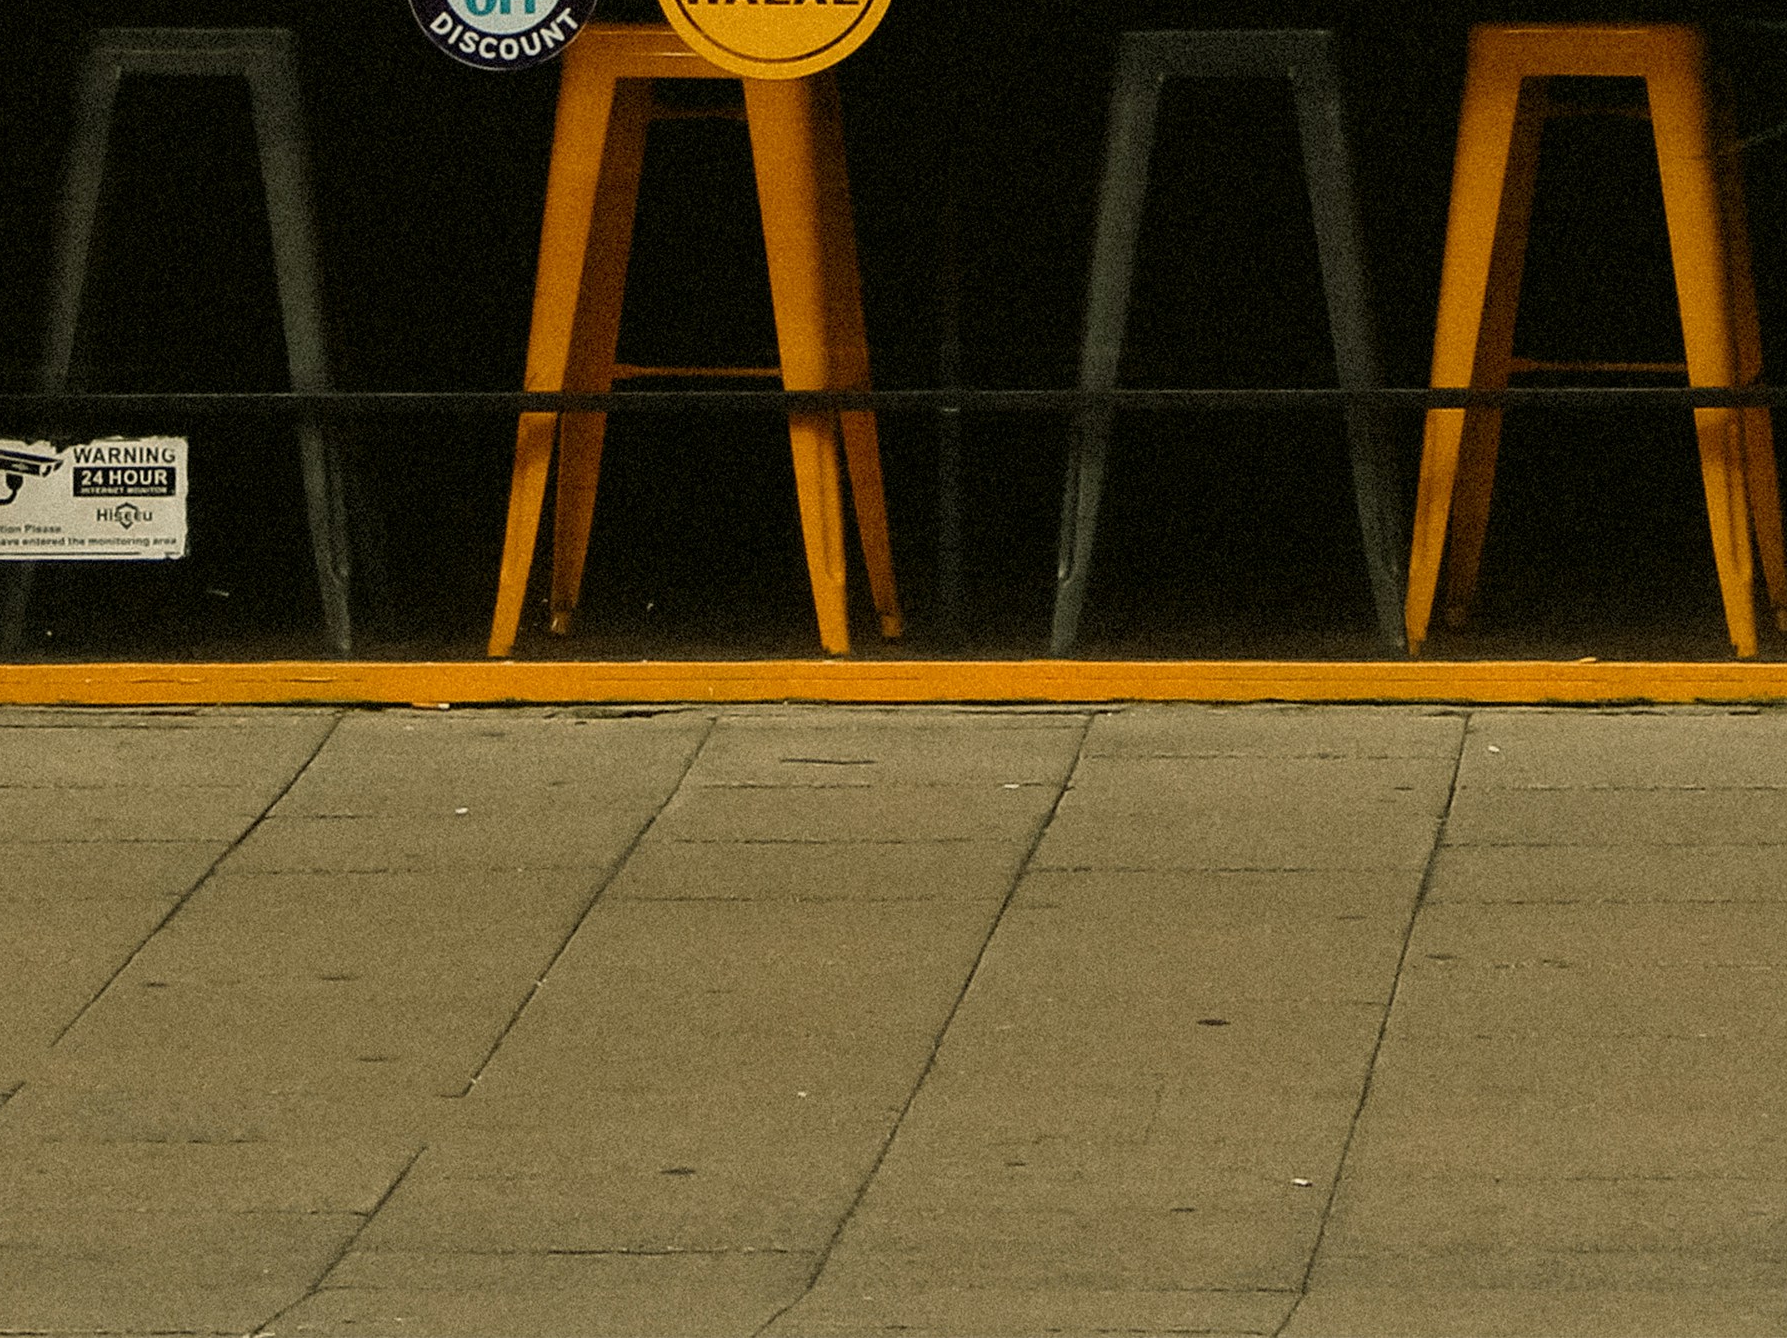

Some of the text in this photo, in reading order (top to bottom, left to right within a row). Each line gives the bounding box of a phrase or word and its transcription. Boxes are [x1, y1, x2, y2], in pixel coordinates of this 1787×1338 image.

[428, 6, 579, 62] DISCOUNT
[73, 446, 176, 464] WARNING
[80, 469, 169, 486] 24 HOUR
[23, 537, 65, 546] entered
[68, 537, 85, 546] the
[153, 538, 177, 546] area
